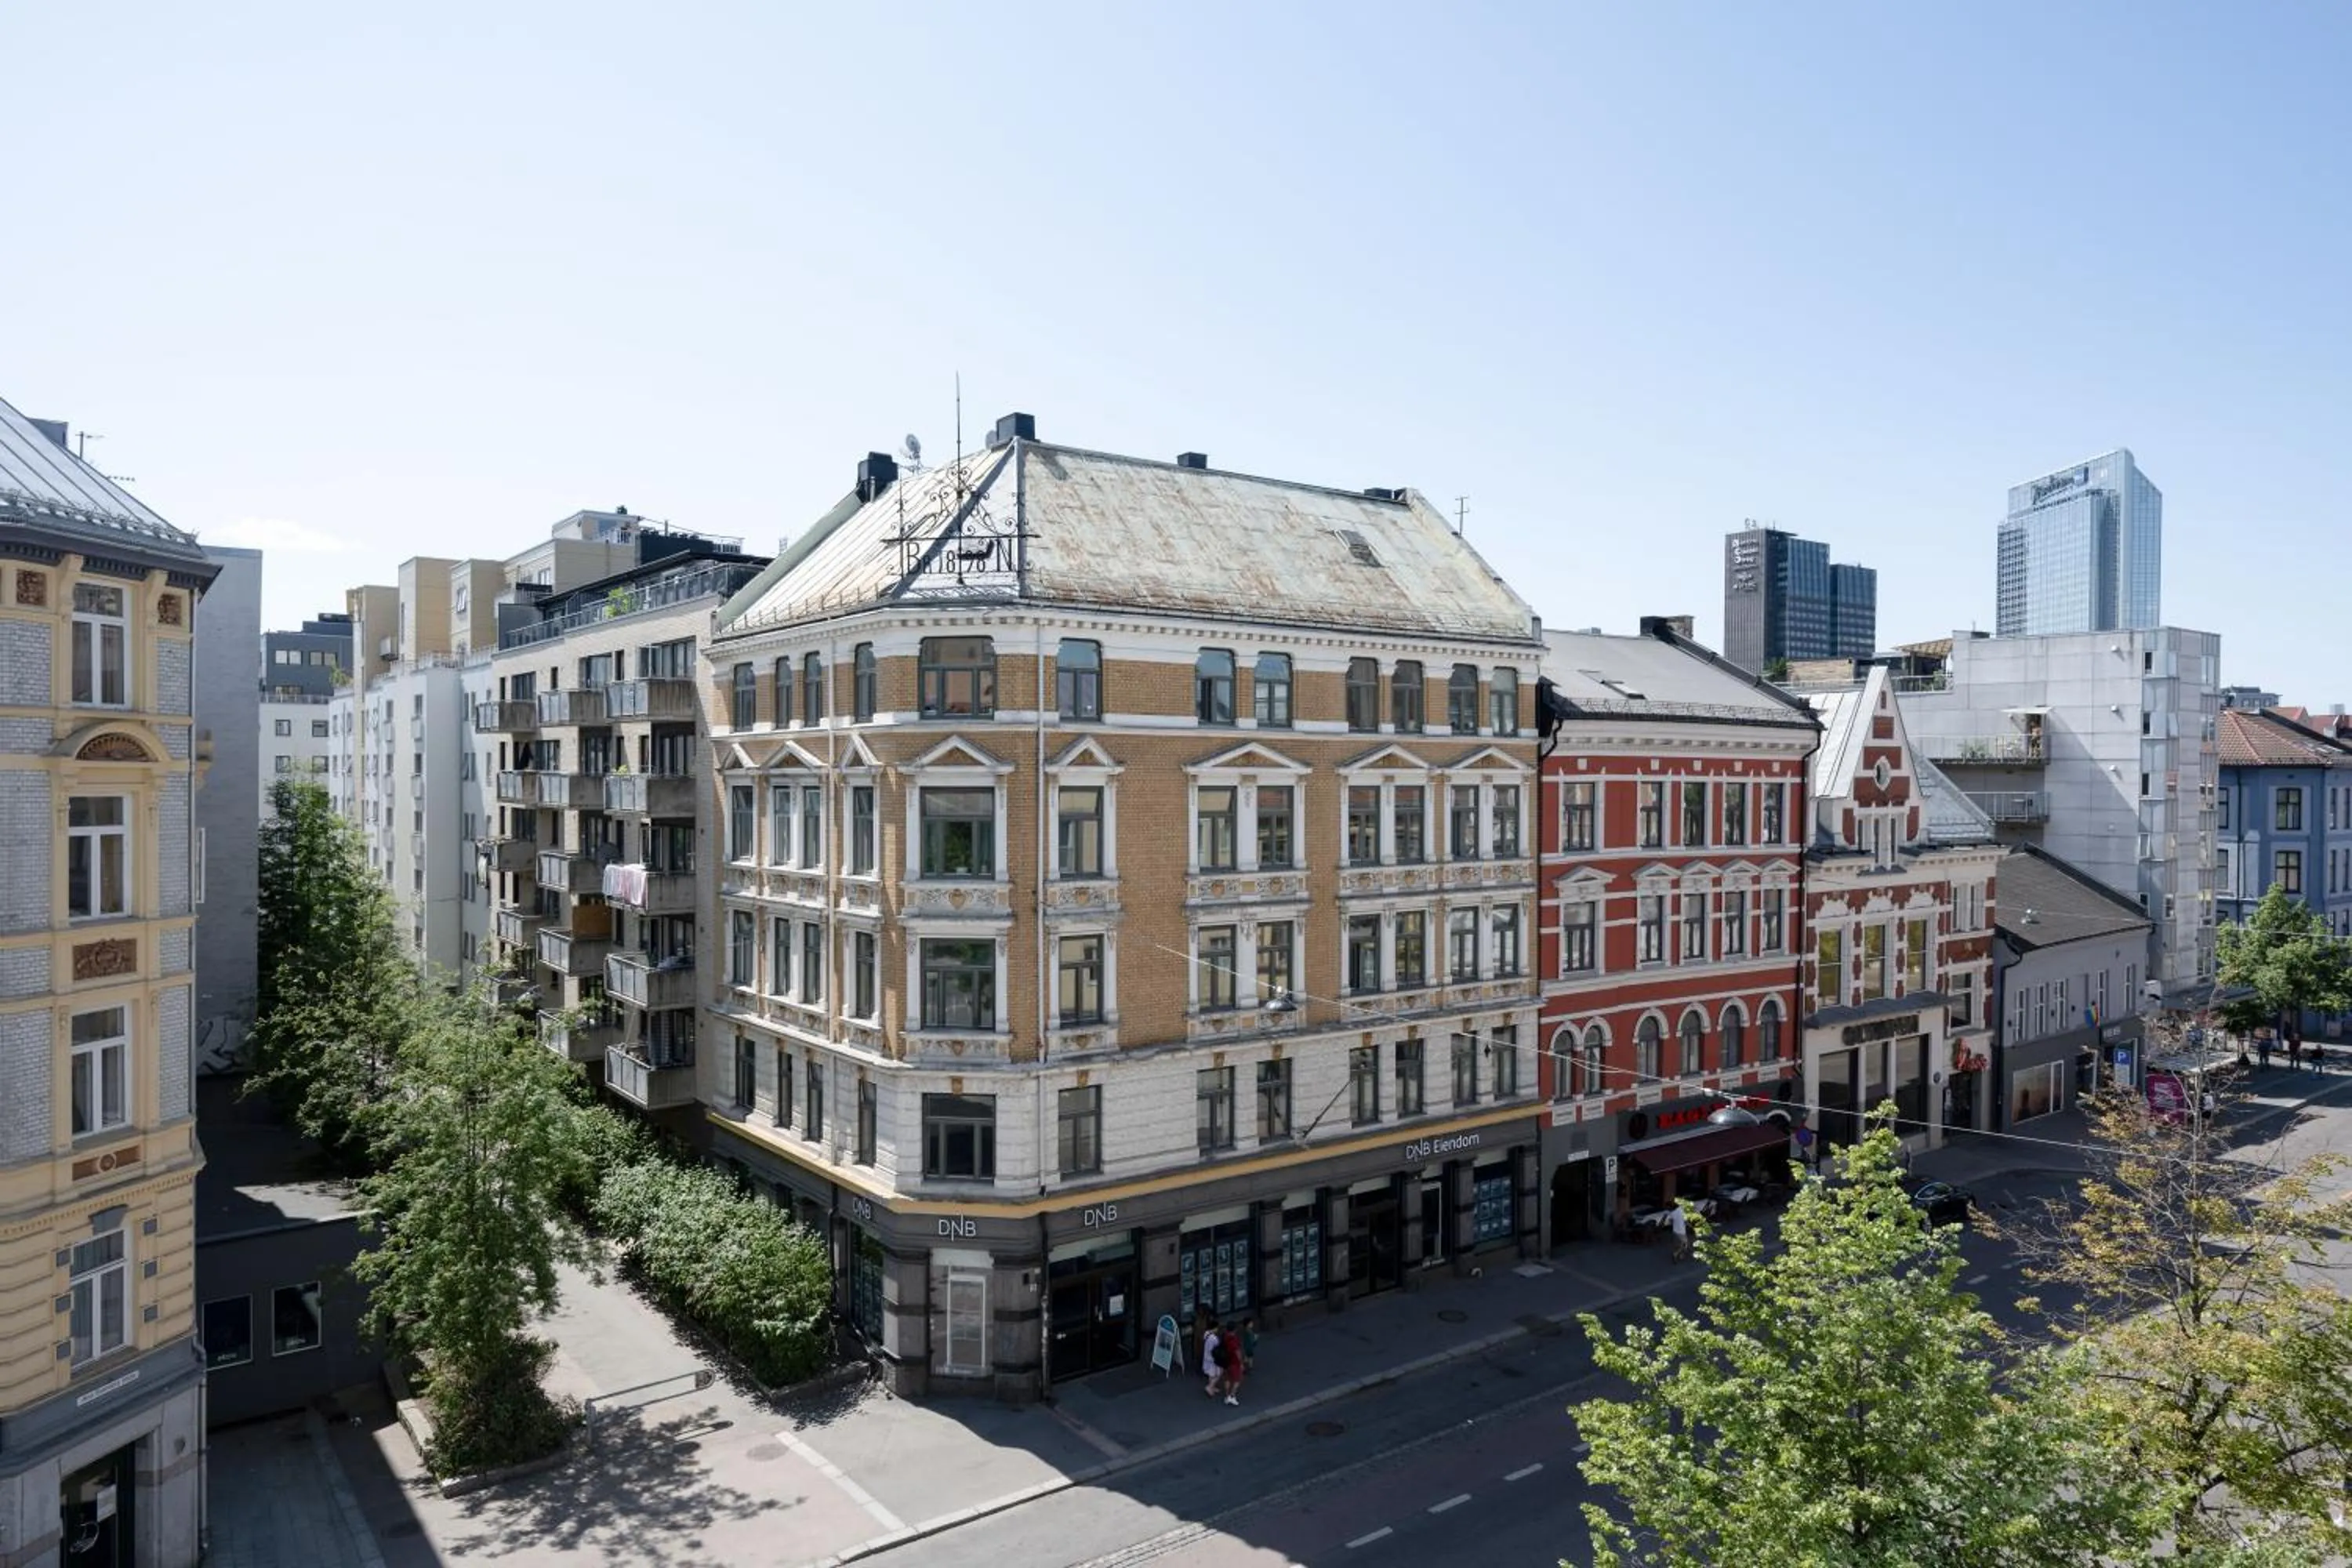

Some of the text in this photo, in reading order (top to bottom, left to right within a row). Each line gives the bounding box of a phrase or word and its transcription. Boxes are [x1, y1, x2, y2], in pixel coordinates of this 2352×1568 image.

[2118, 1051, 2126, 1062] P
[1406, 1134, 1479, 1162] DNB Eiendom
[1608, 1160, 1616, 1172] P
[853, 1198, 871, 1219] DNB
[1085, 1202, 1117, 1229] DNB
[938, 1212, 976, 1242] DNB
